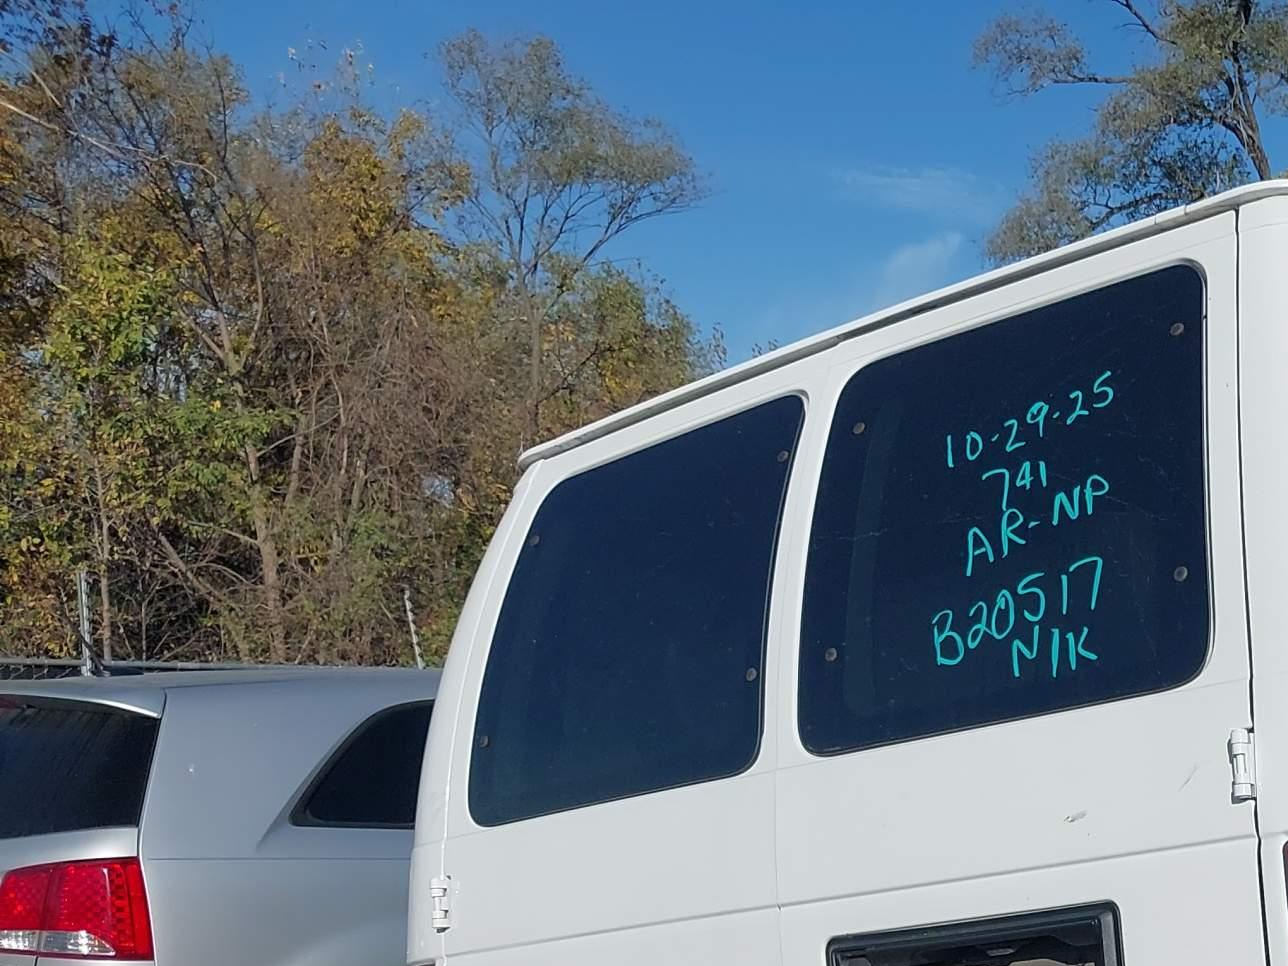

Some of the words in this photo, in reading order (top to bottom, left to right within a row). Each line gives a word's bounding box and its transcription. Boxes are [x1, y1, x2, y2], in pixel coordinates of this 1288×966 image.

[966, 475, 1109, 577] AR-NP
[982, 461, 1047, 511] 741
[932, 556, 1103, 666] B20517
